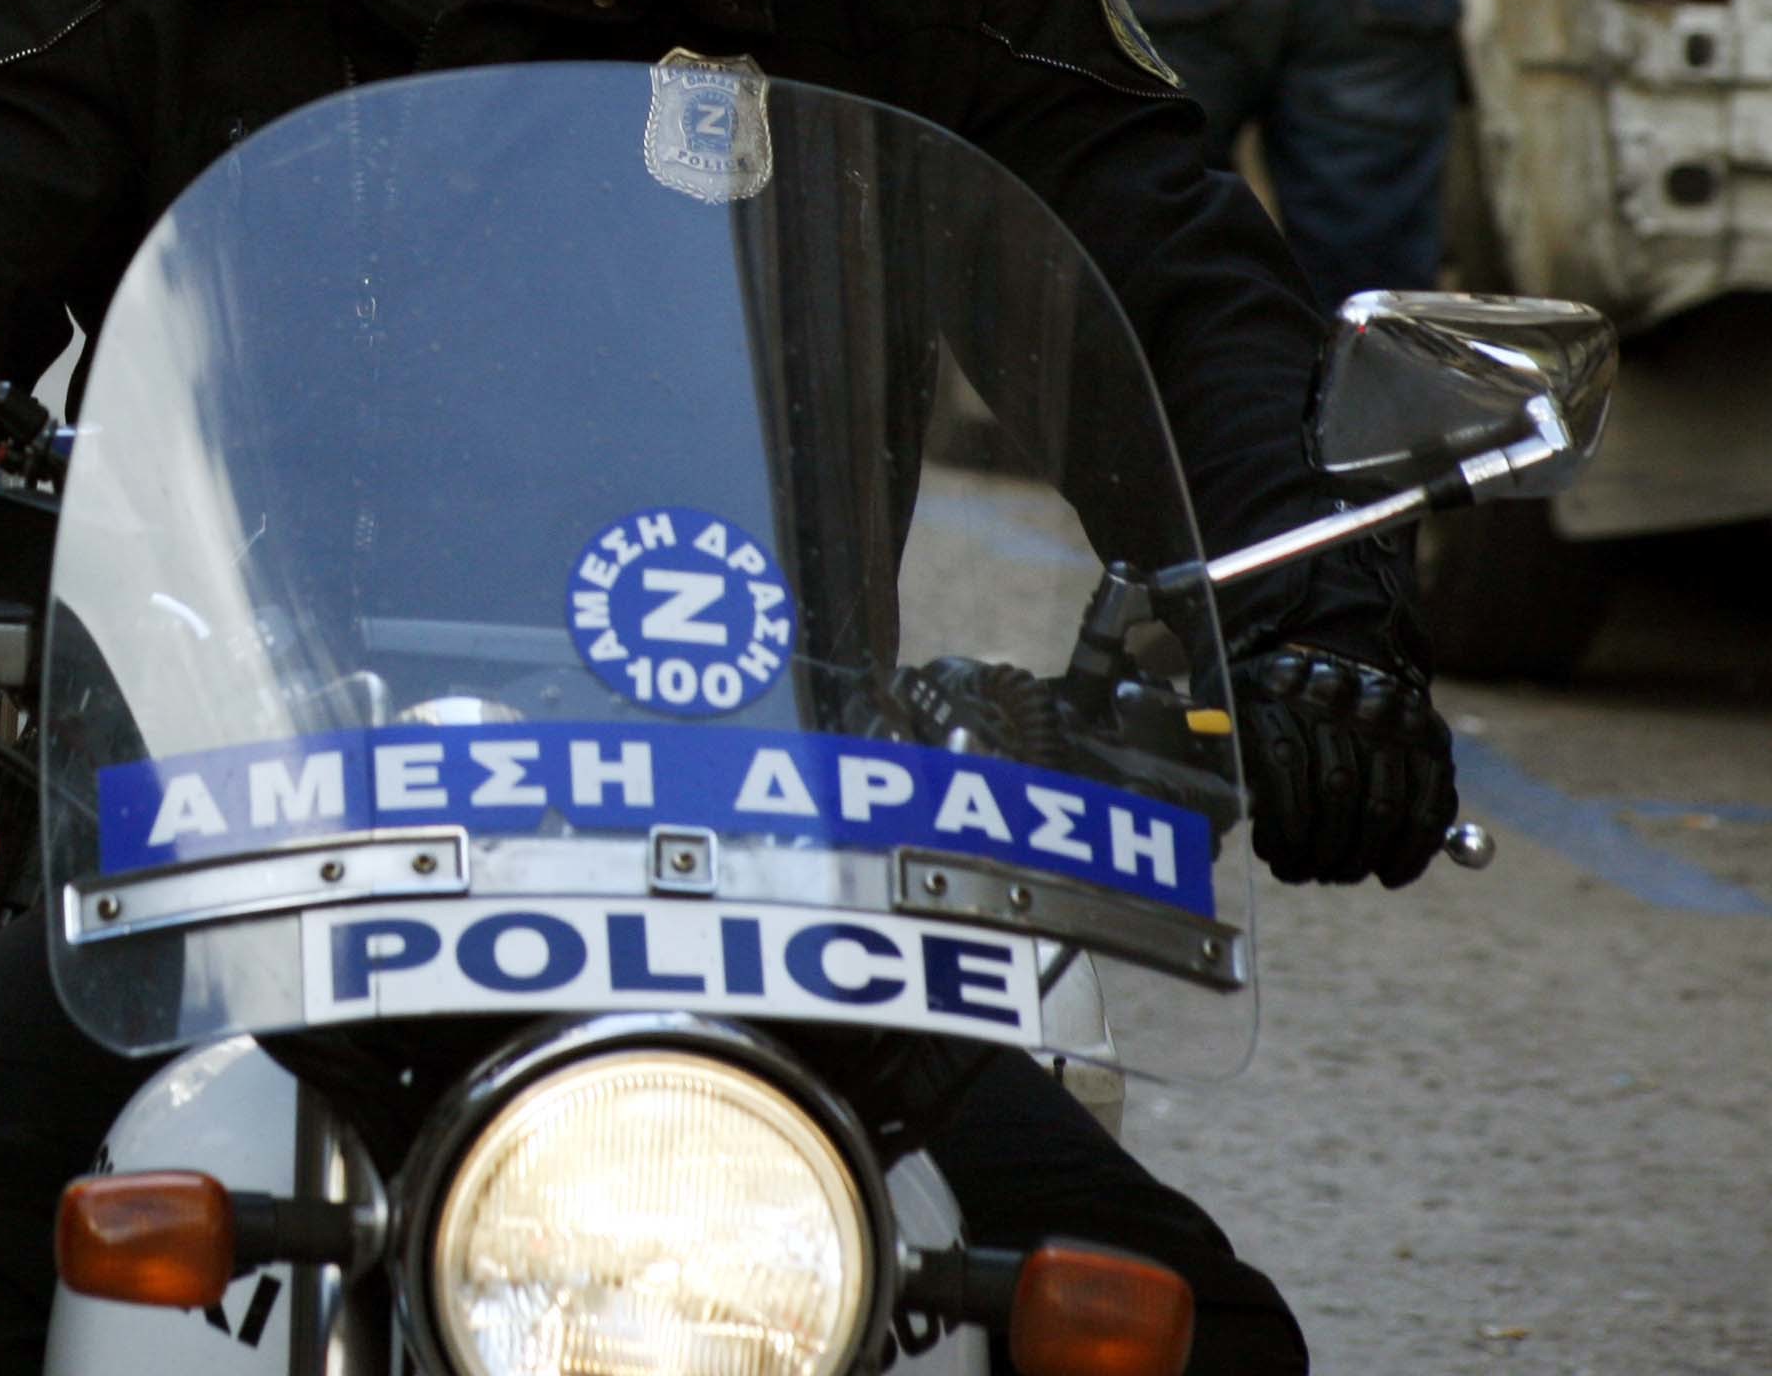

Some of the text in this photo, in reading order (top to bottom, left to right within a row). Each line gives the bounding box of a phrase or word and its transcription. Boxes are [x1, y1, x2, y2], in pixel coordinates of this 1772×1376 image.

[573, 513, 791, 684] ΑΜΕΣΗ ΔΡΑΣΗ
[625, 656, 744, 709] 100
[147, 740, 1177, 888] ΑΜΕΣΗ ΔΡΑΣΗ
[330, 911, 1021, 1028] POLICE
